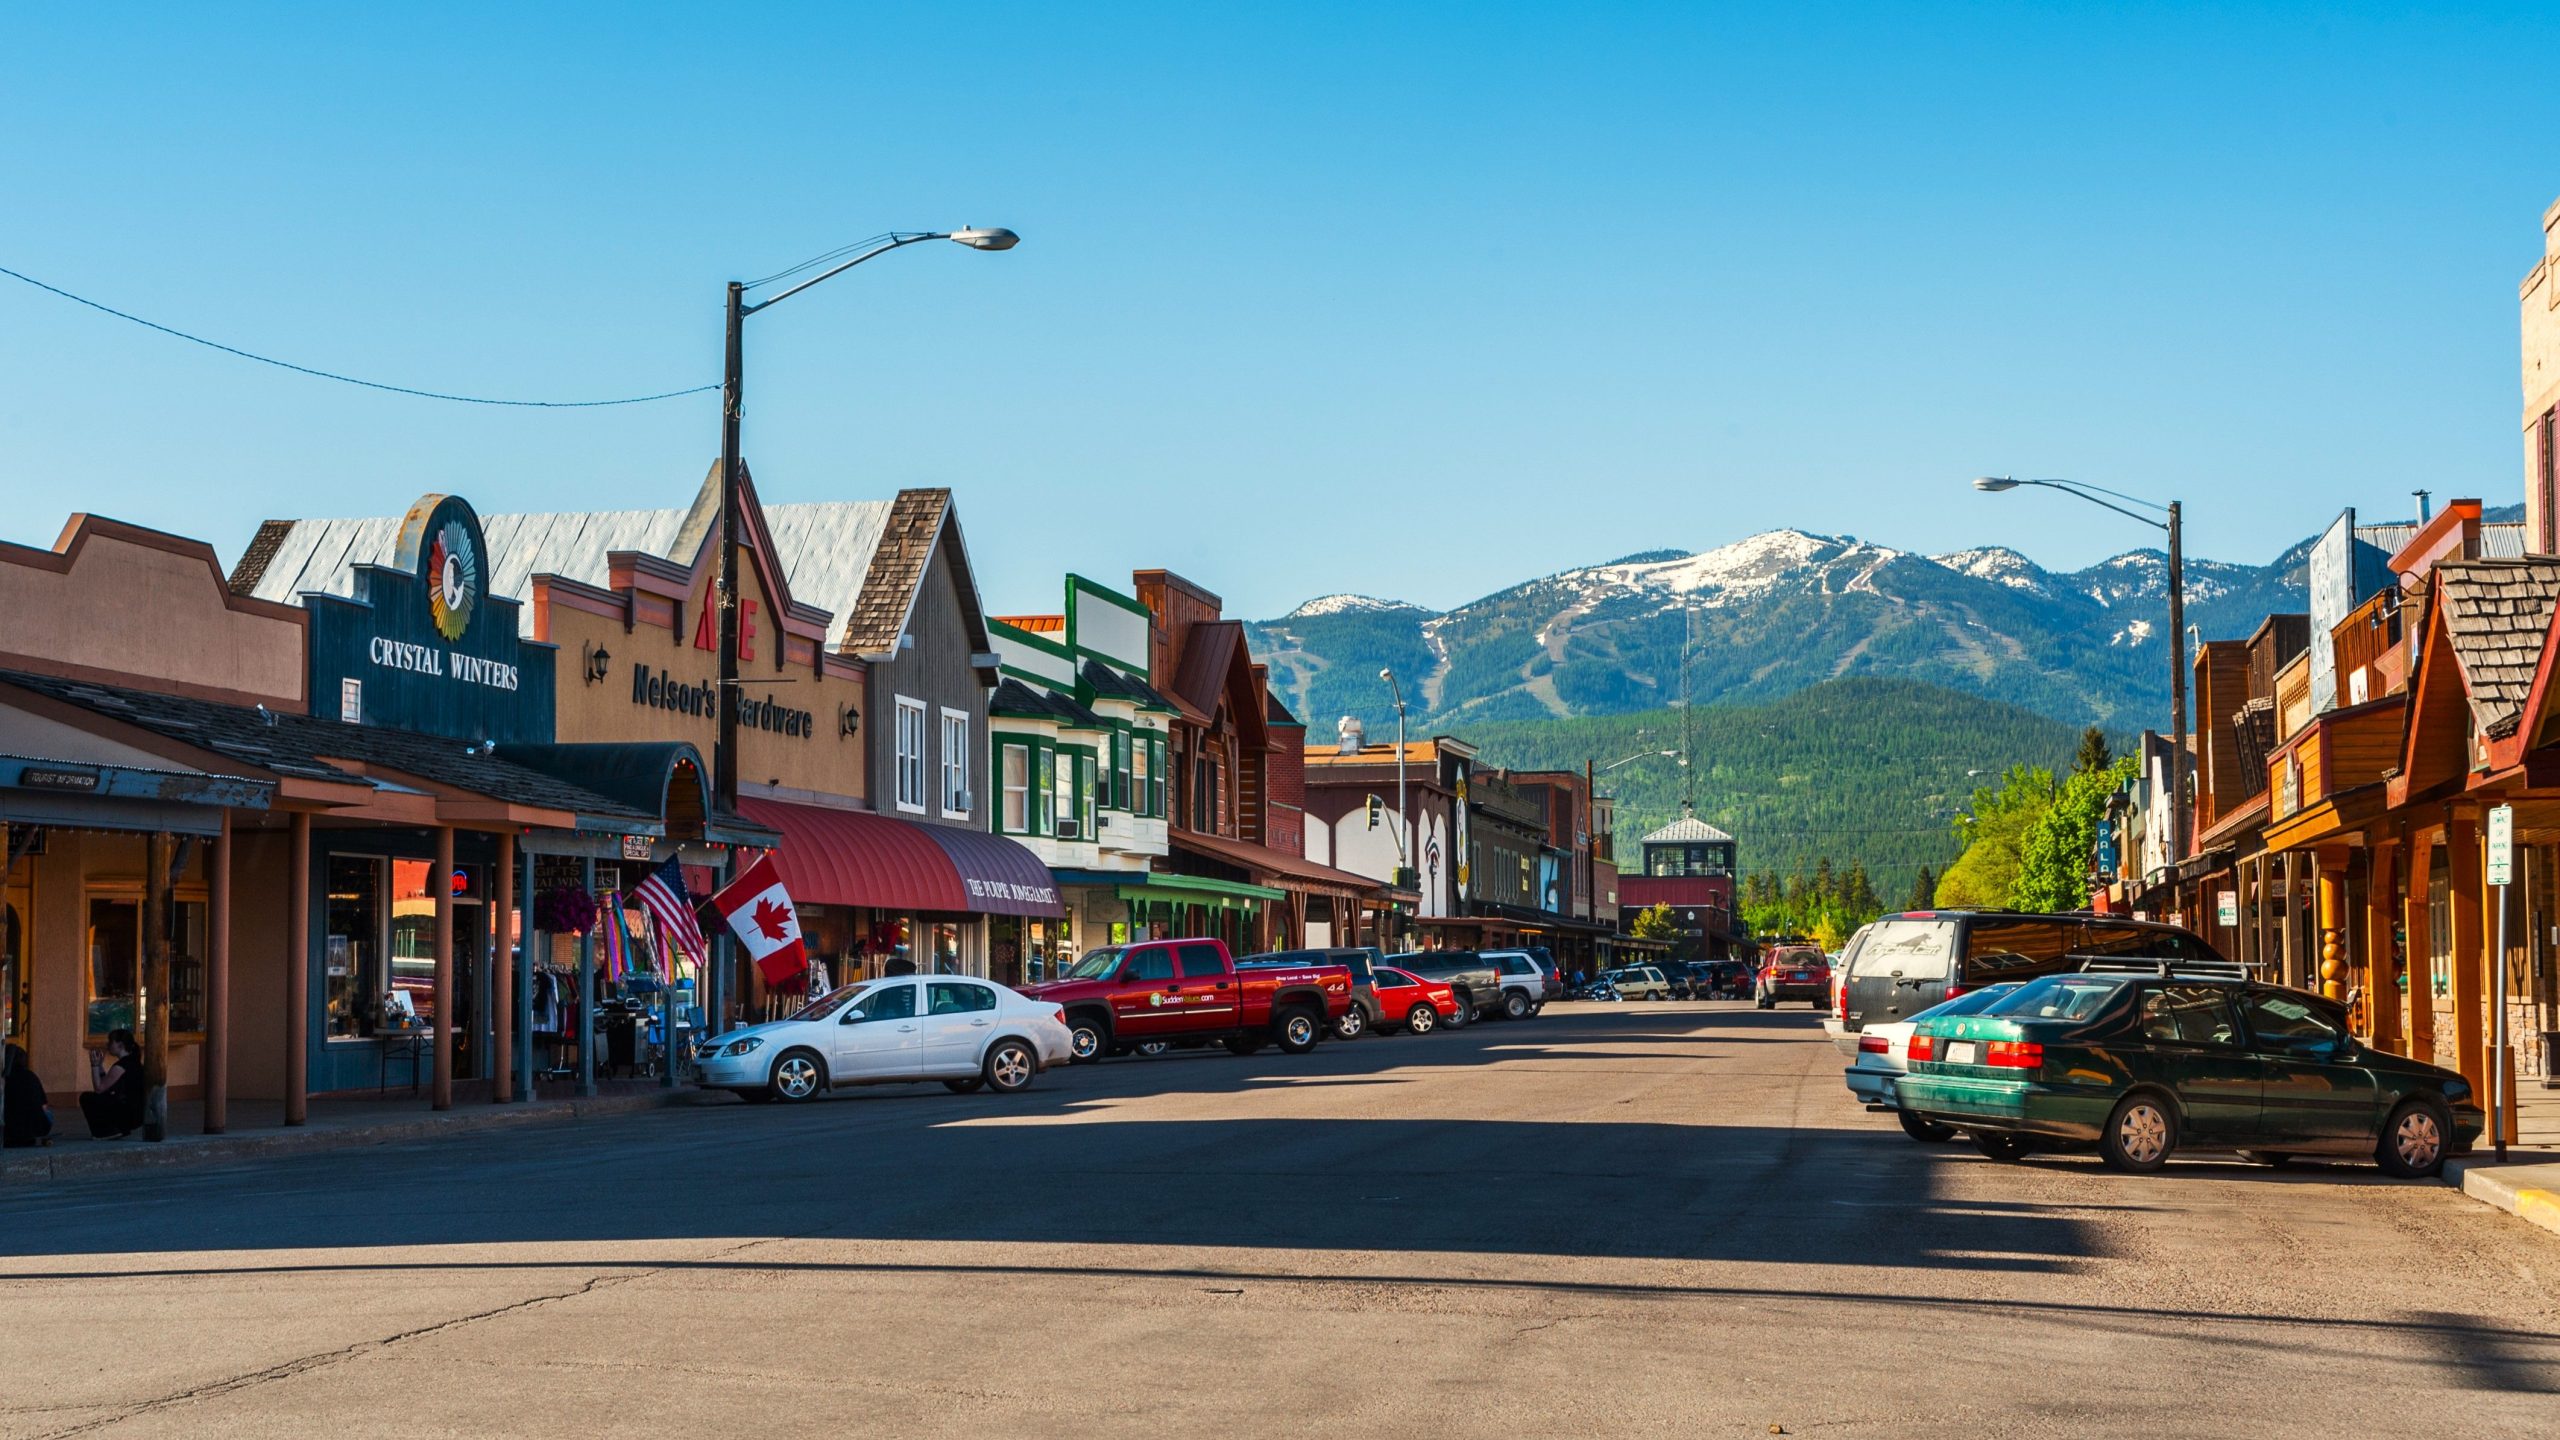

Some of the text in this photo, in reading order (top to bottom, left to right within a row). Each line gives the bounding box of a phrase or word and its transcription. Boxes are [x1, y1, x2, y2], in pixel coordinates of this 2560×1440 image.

[693, 575, 758, 662] AE
[369, 636, 518, 691] CRYSTAL WINTERS
[632, 663, 716, 719] Nelson's
[535, 866, 580, 878] GIFTS
[967, 878, 984, 897] THE
